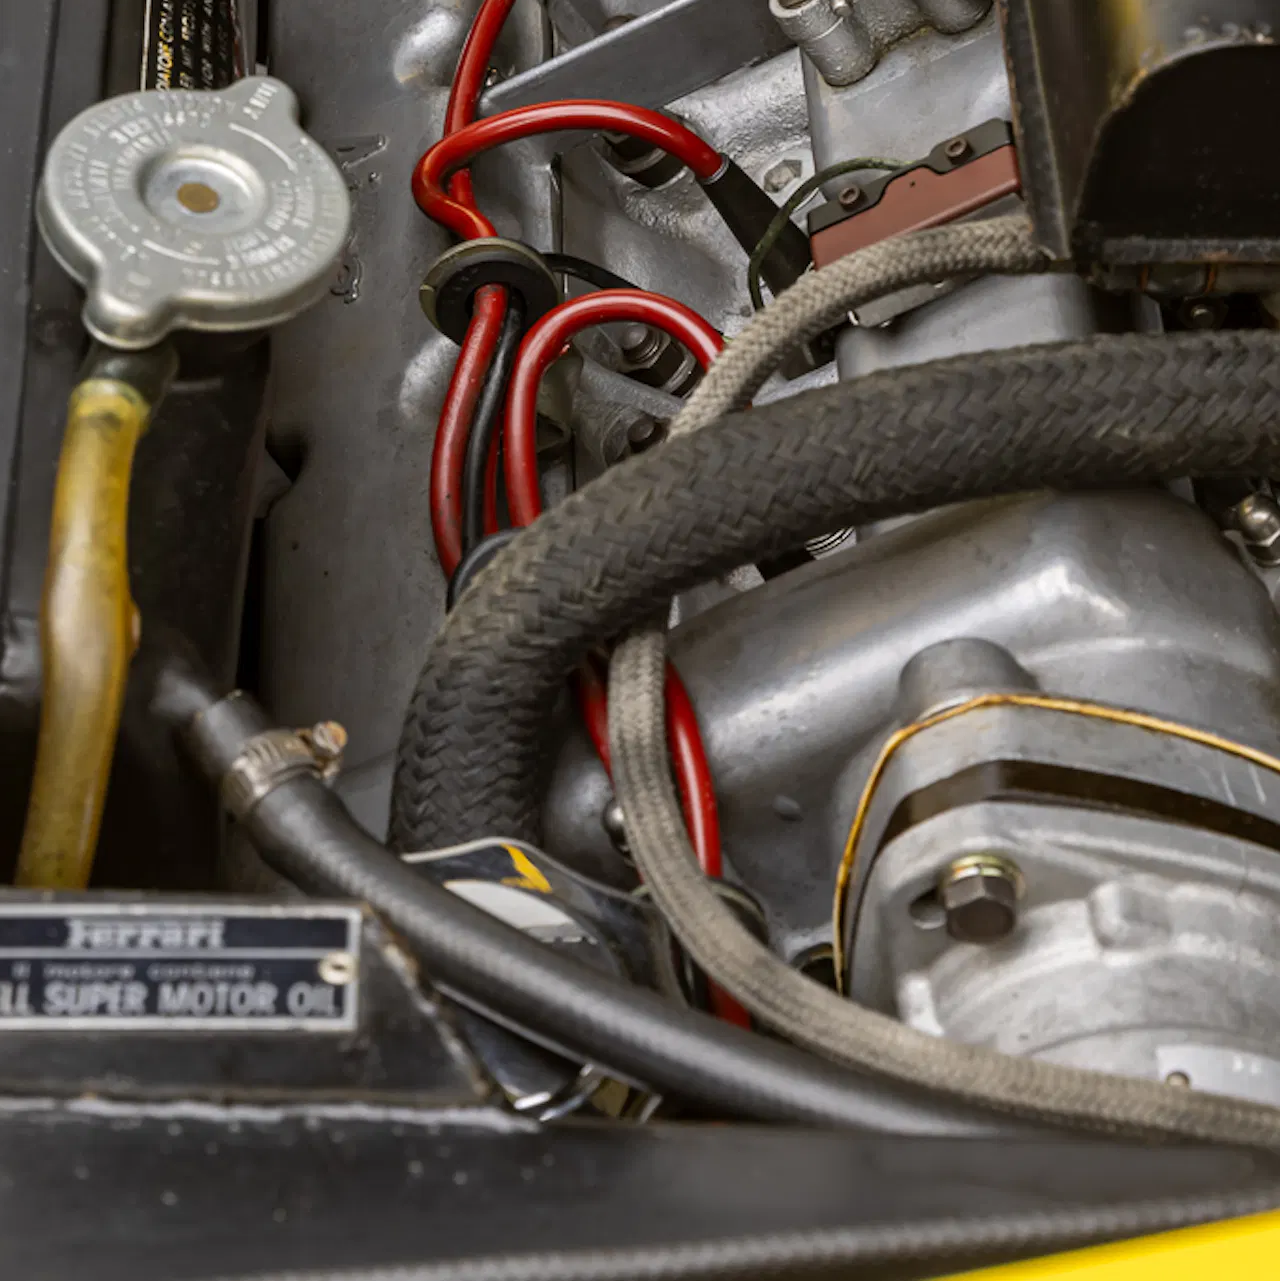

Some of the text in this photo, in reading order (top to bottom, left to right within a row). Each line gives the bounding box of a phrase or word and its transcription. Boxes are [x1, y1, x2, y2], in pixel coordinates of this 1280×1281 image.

[66, 918, 225, 950] Ferrari
[43, 983, 147, 1016] SUPER
[157, 984, 278, 1015] MOTOR
[287, 984, 340, 1017] OIL
